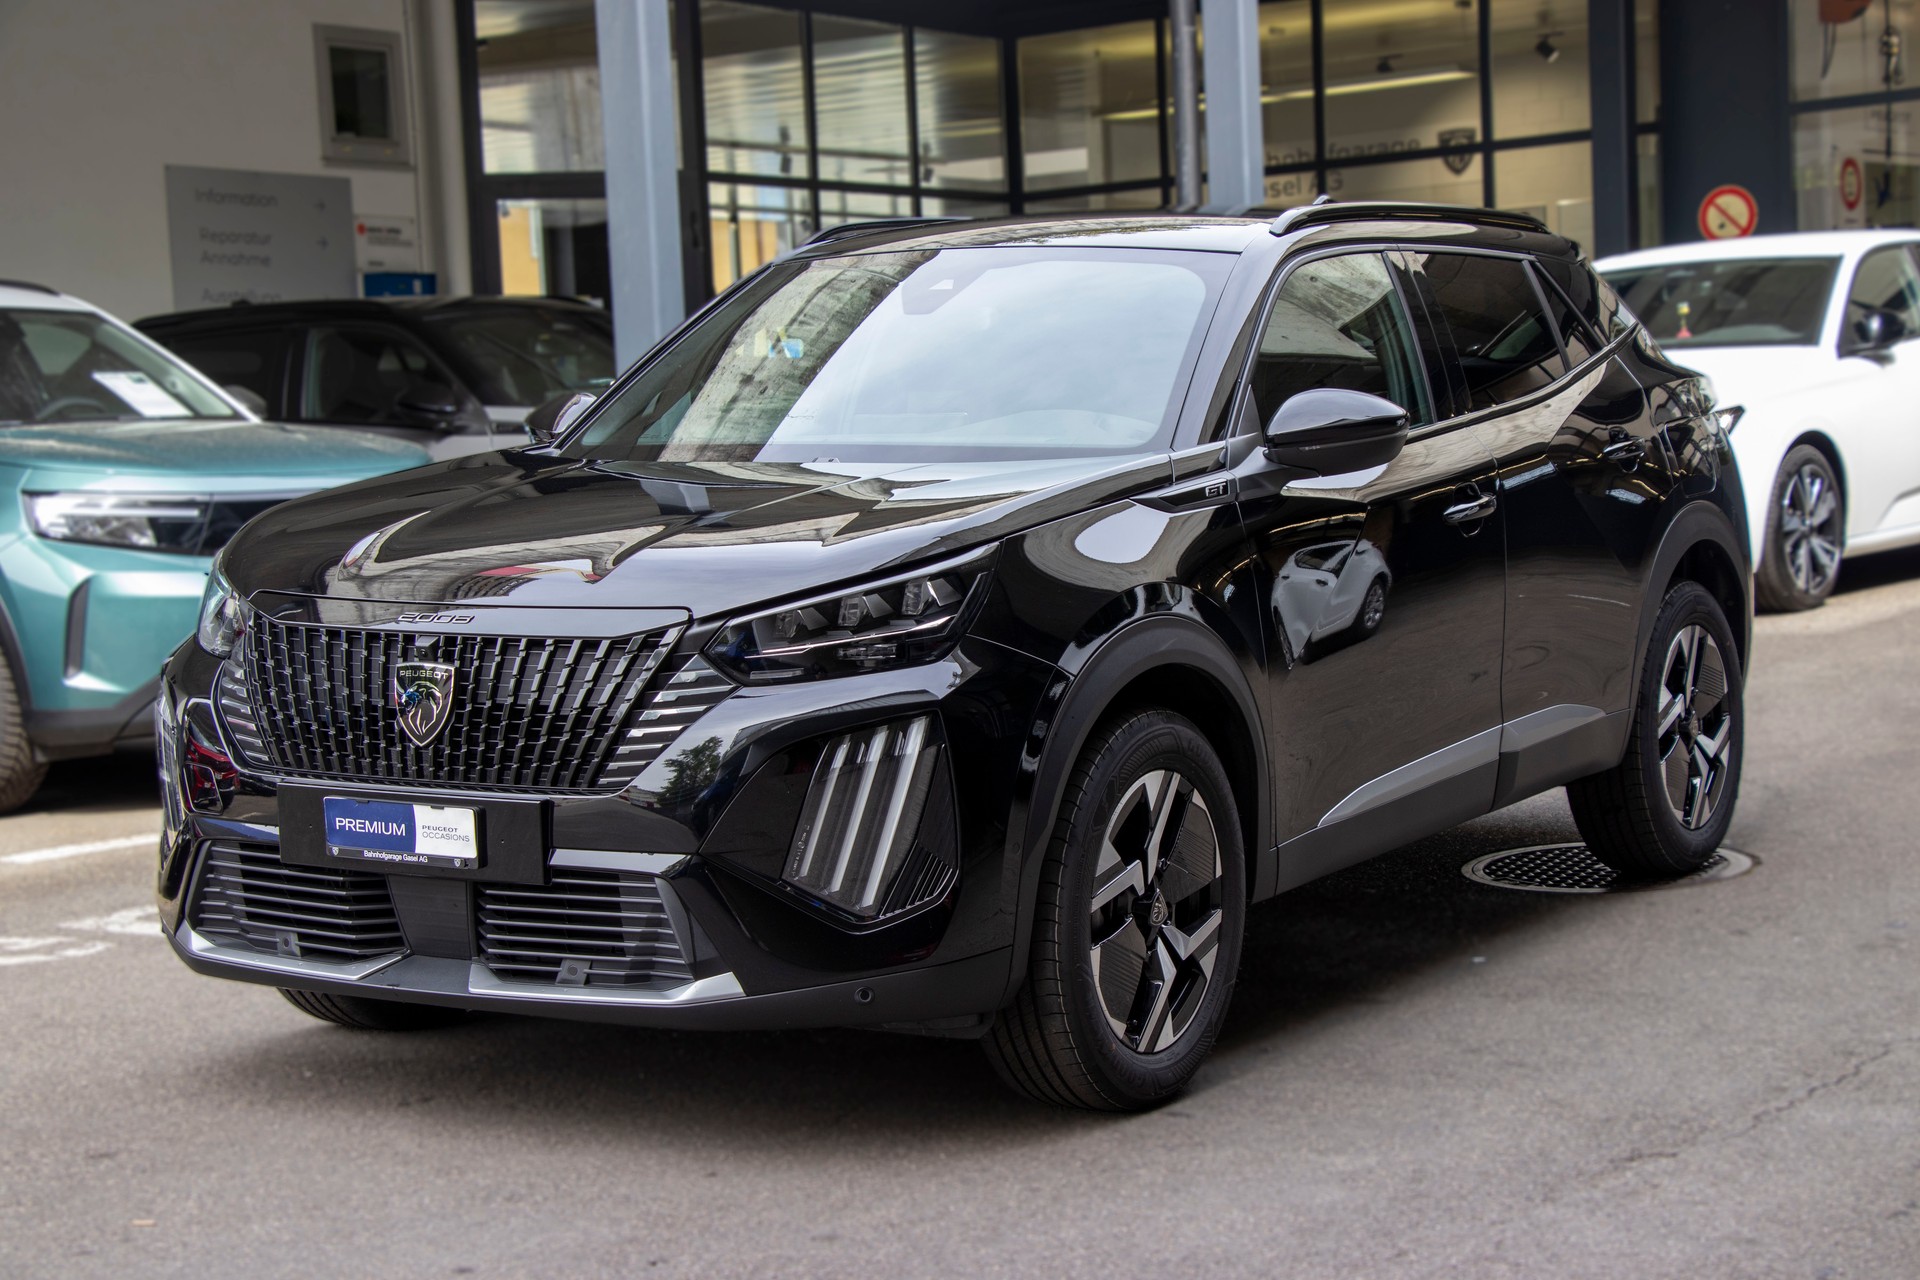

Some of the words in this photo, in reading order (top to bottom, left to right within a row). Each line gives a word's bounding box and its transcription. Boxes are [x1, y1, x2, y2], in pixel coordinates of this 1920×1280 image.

[195, 188, 278, 207] Information
[199, 227, 272, 245] Reparatur
[201, 250, 271, 267] Annahme
[1205, 482, 1226, 497] GT
[398, 612, 475, 624] 2008
[400, 670, 448, 679] PEUGEOT
[335, 817, 406, 836] PREMIUM
[422, 824, 459, 832] PEUGEOT
[422, 831, 470, 842] OCCASIONS
[364, 850, 402, 861] Bahnhofgarage
